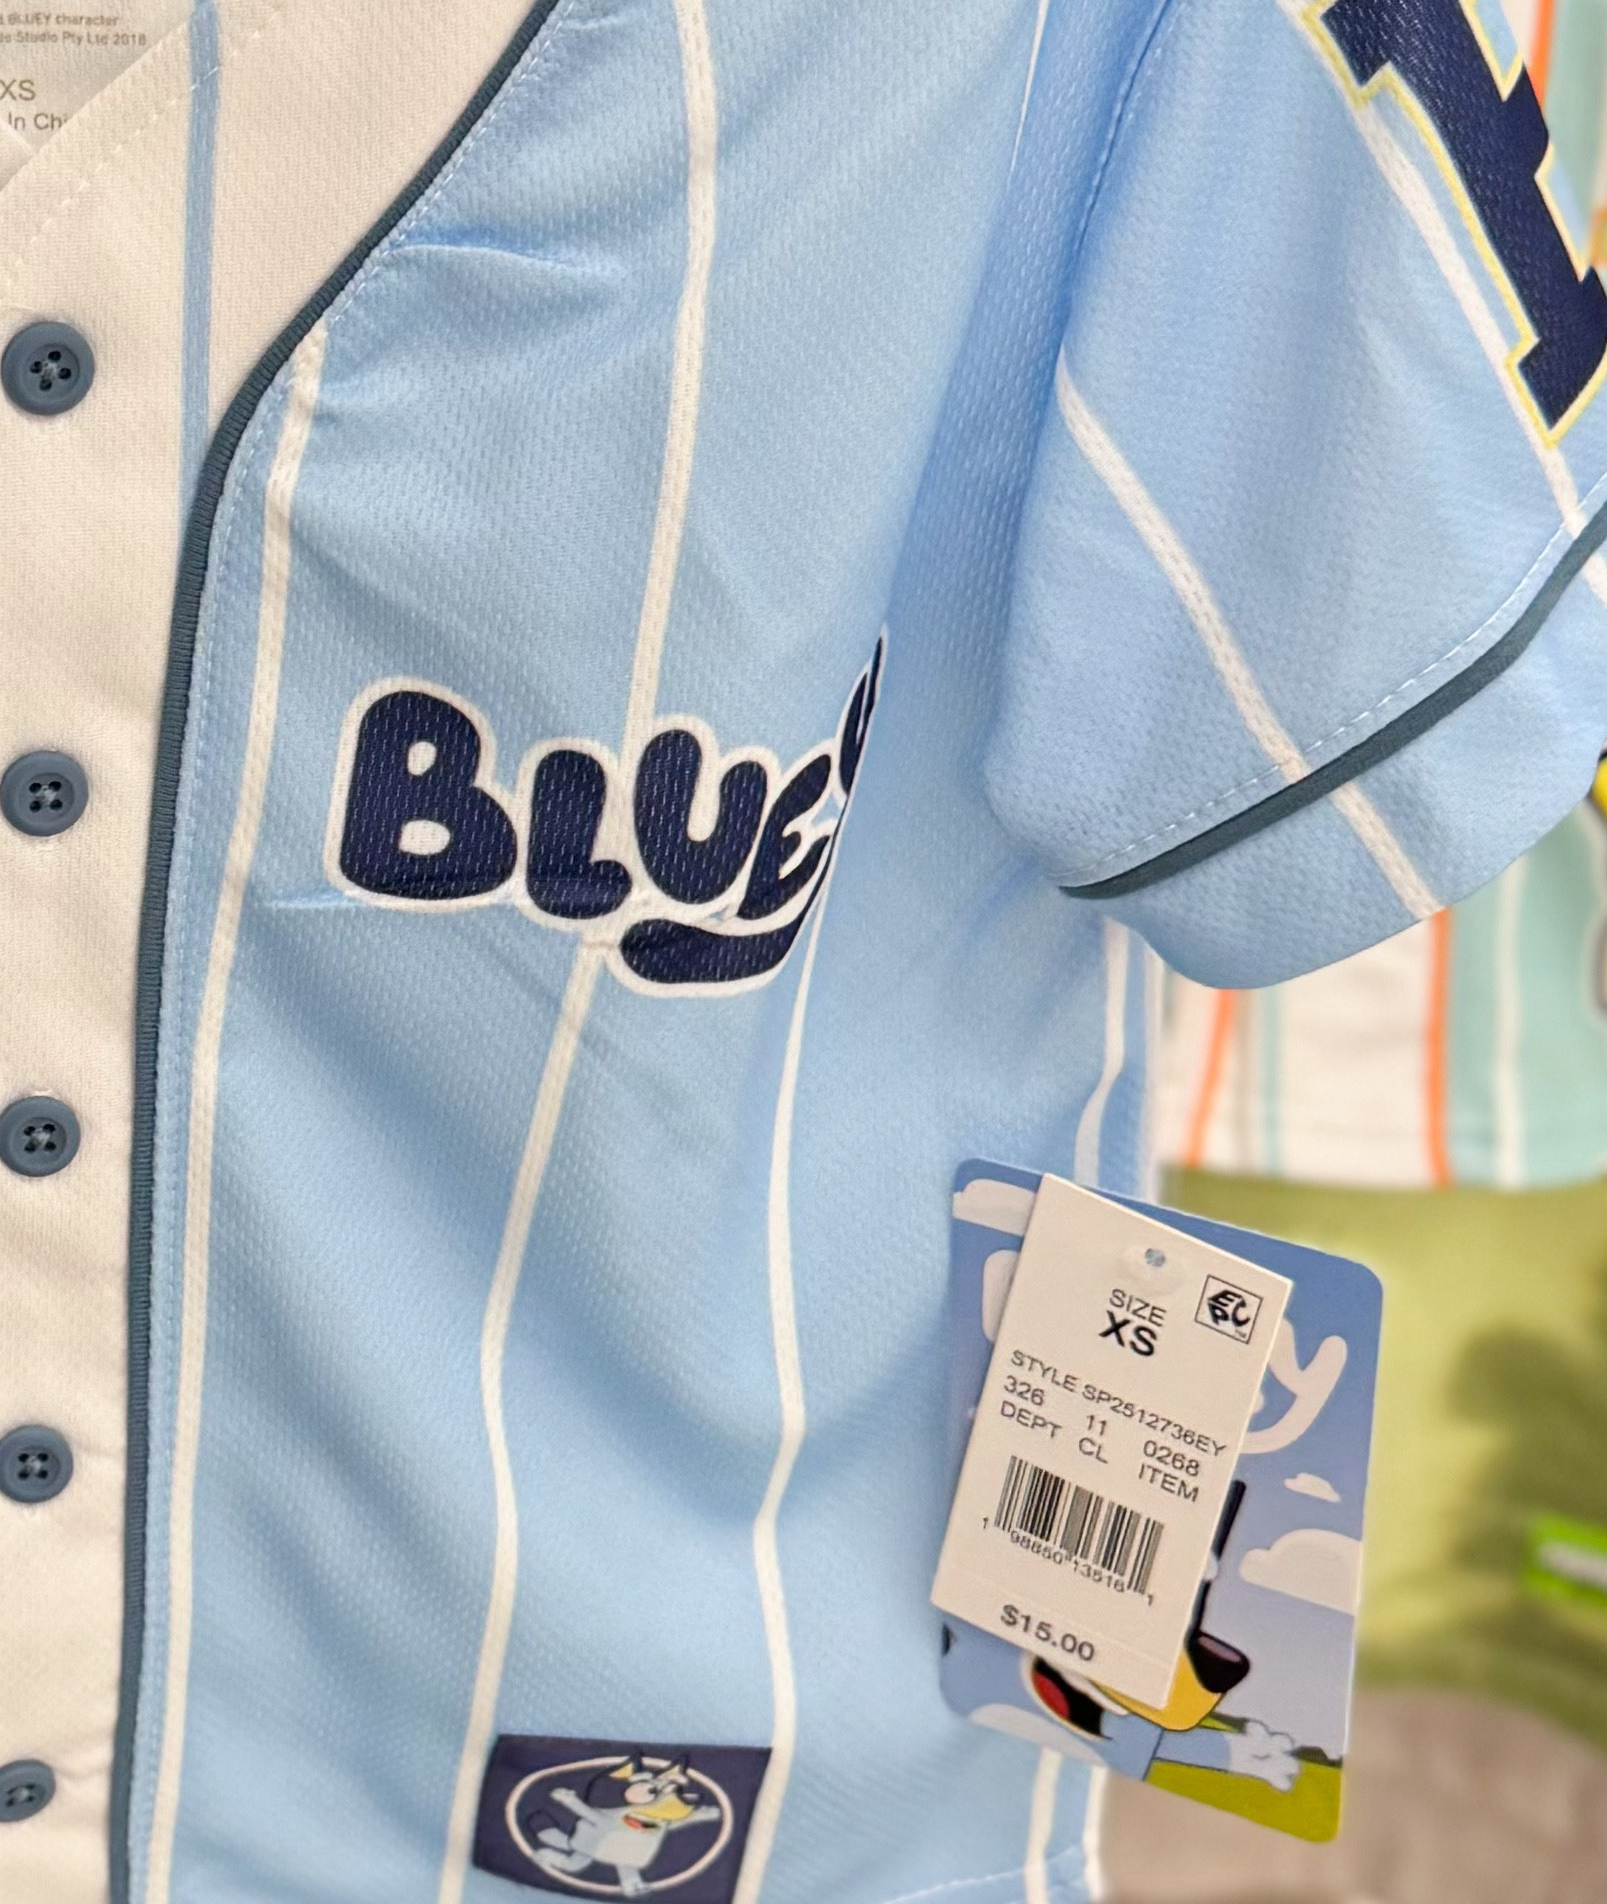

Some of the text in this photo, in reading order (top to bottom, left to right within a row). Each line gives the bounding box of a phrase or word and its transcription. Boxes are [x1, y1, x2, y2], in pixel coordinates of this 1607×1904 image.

[8, 11, 52, 26] BLUEY
[15, 30, 59, 44] Studio
[62, 30, 83, 46] Pty
[87, 32, 108, 46] Ltd
[331, 628, 887, 992] BLUEY
[1098, 1309, 1157, 1356] XS
[1109, 1288, 1167, 1327] SIZE
[1003, 1375, 1200, 1478] 326 11 0268
[1010, 1349, 1078, 1393] STYLE
[1081, 1383, 1228, 1457] SP2512736EY
[999, 1399, 1200, 1503] DEPT CL ITEM
[981, 1516, 989, 1530] 1
[1146, 1593, 1155, 1607] 1
[1000, 1603, 1096, 1662] $15.00
